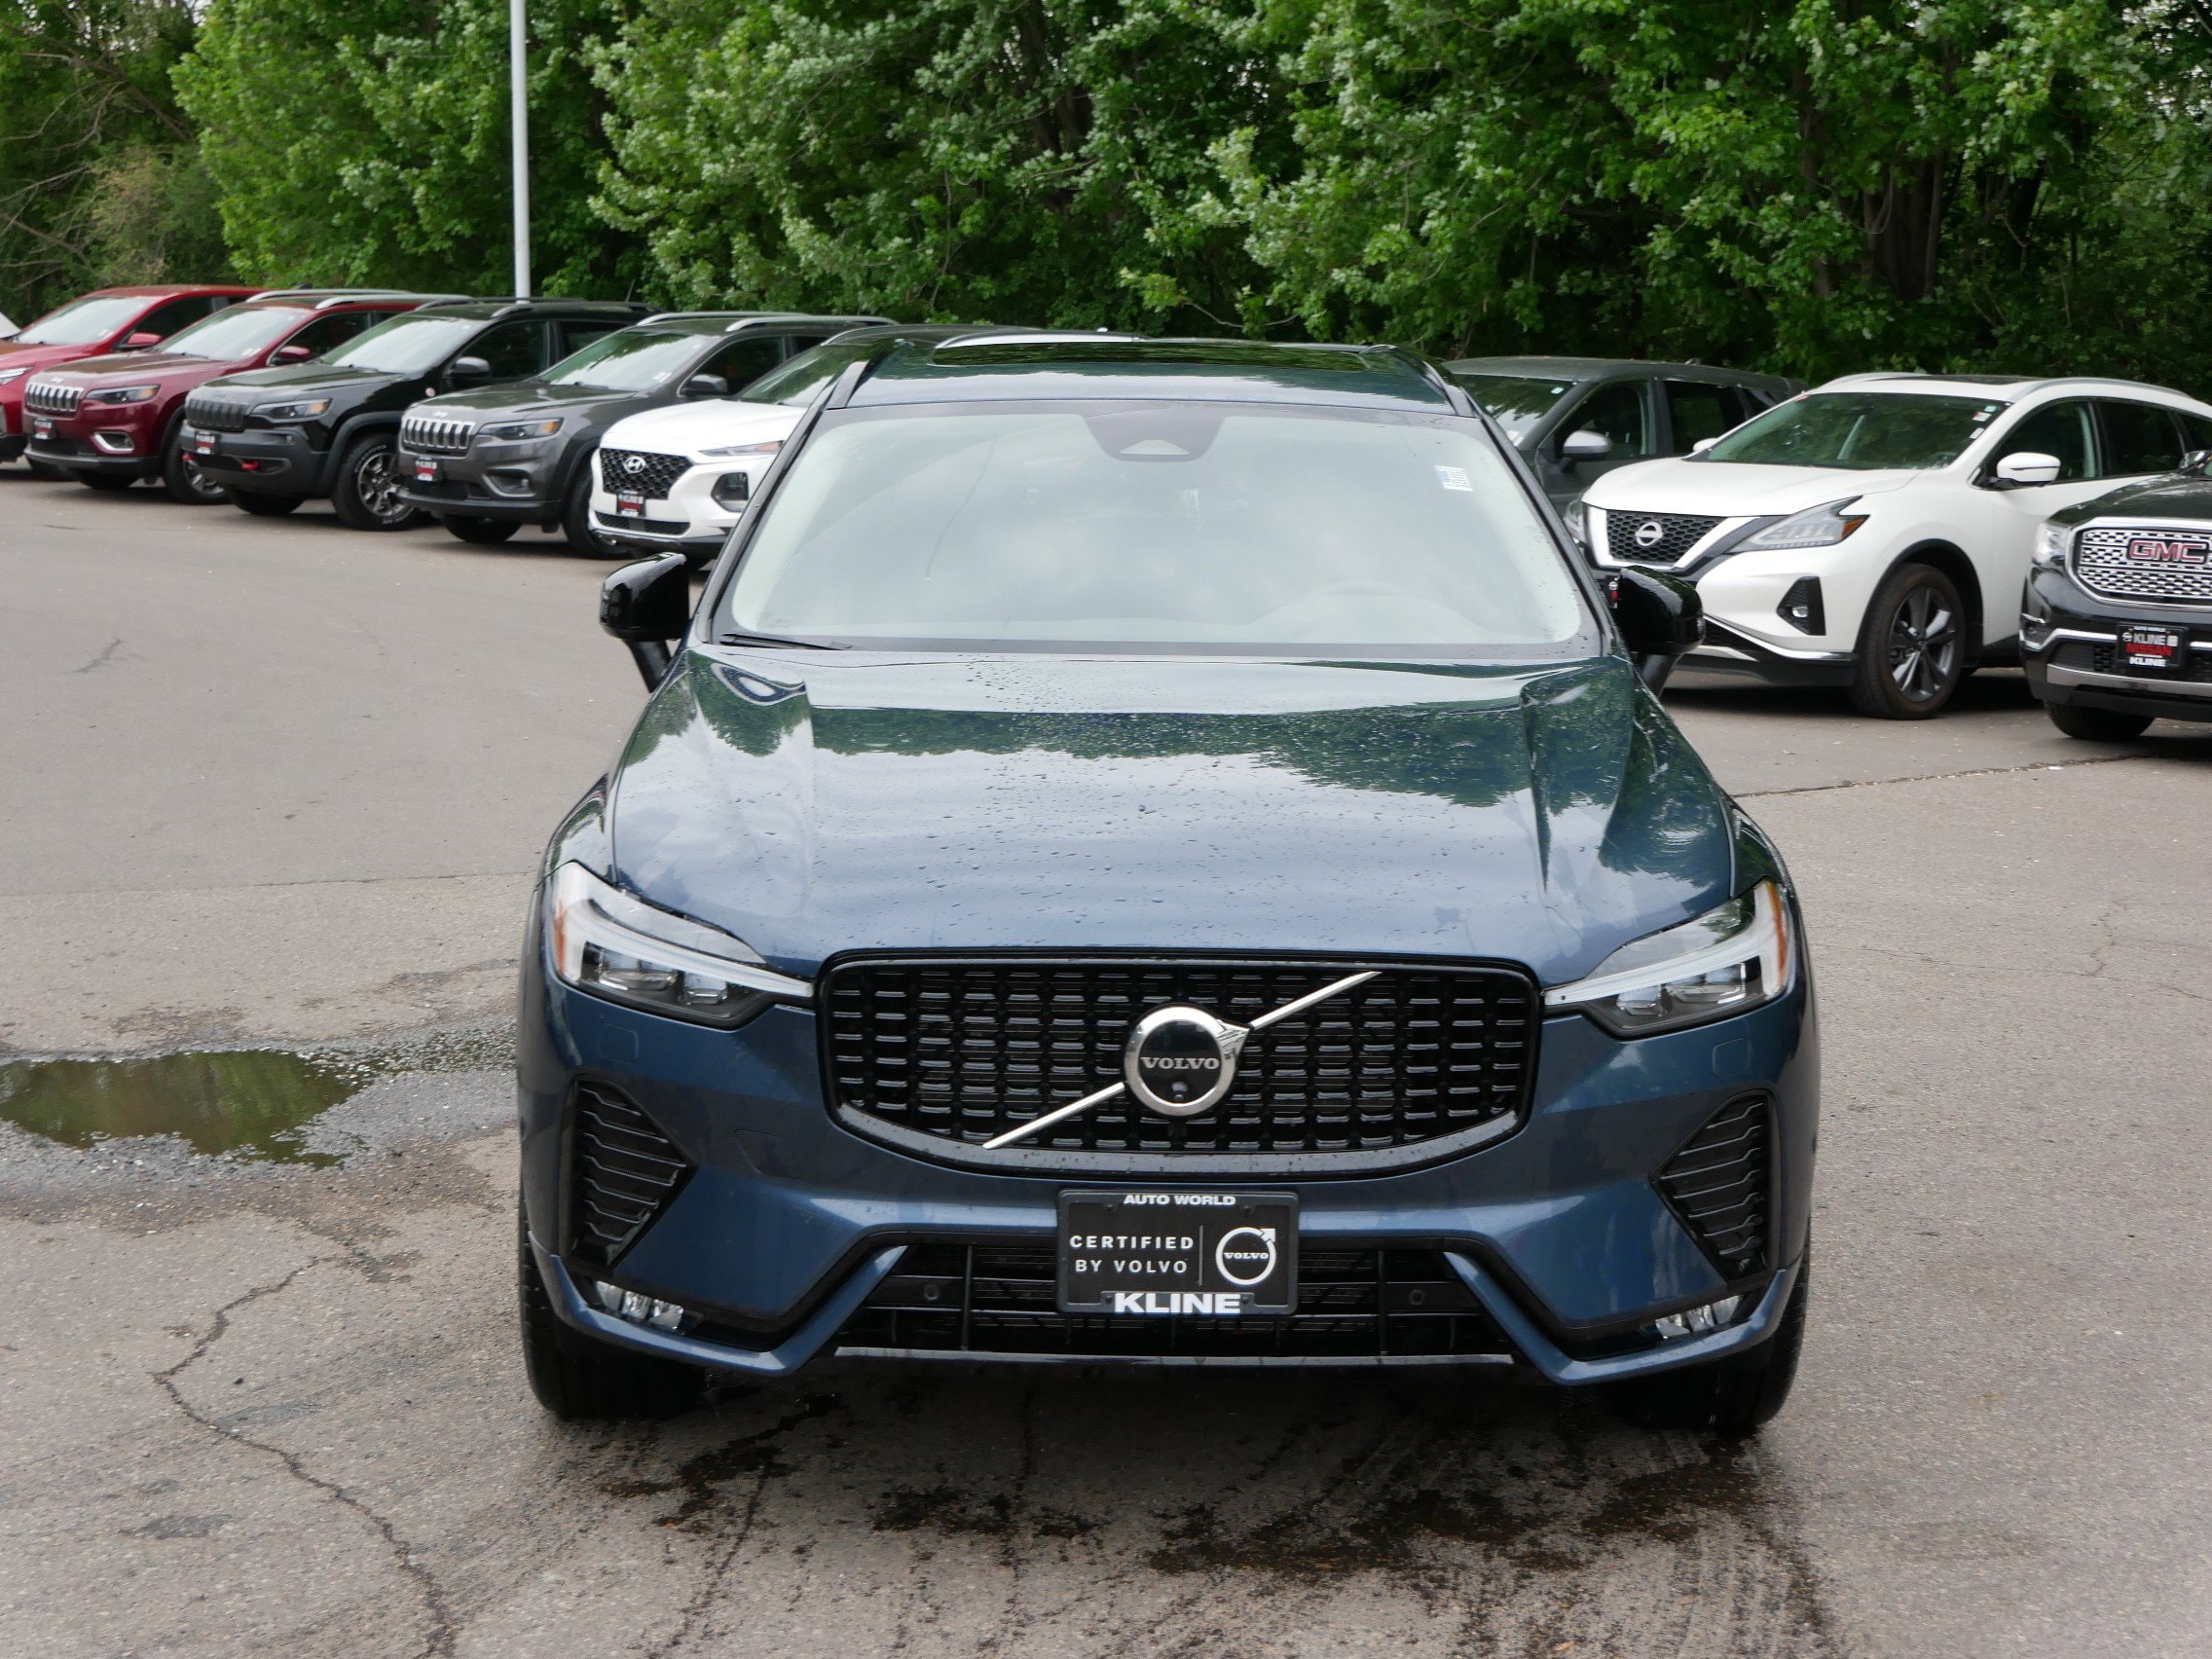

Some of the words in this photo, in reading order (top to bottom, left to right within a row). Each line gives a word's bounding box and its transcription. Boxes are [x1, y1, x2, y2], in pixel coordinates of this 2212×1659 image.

[2129, 539, 2203, 563] GMC
[1140, 1056, 1220, 1070] VOLVO
[1124, 1194, 1169, 1205] AUTO
[1174, 1194, 1236, 1205] WORLD
[1069, 1235, 1194, 1249] CERTIFIED
[1223, 1251, 1270, 1260] VOLVO
[1075, 1259, 1102, 1272] BY
[1114, 1259, 1188, 1273] VOLVO
[1114, 1292, 1241, 1314] KLINE
